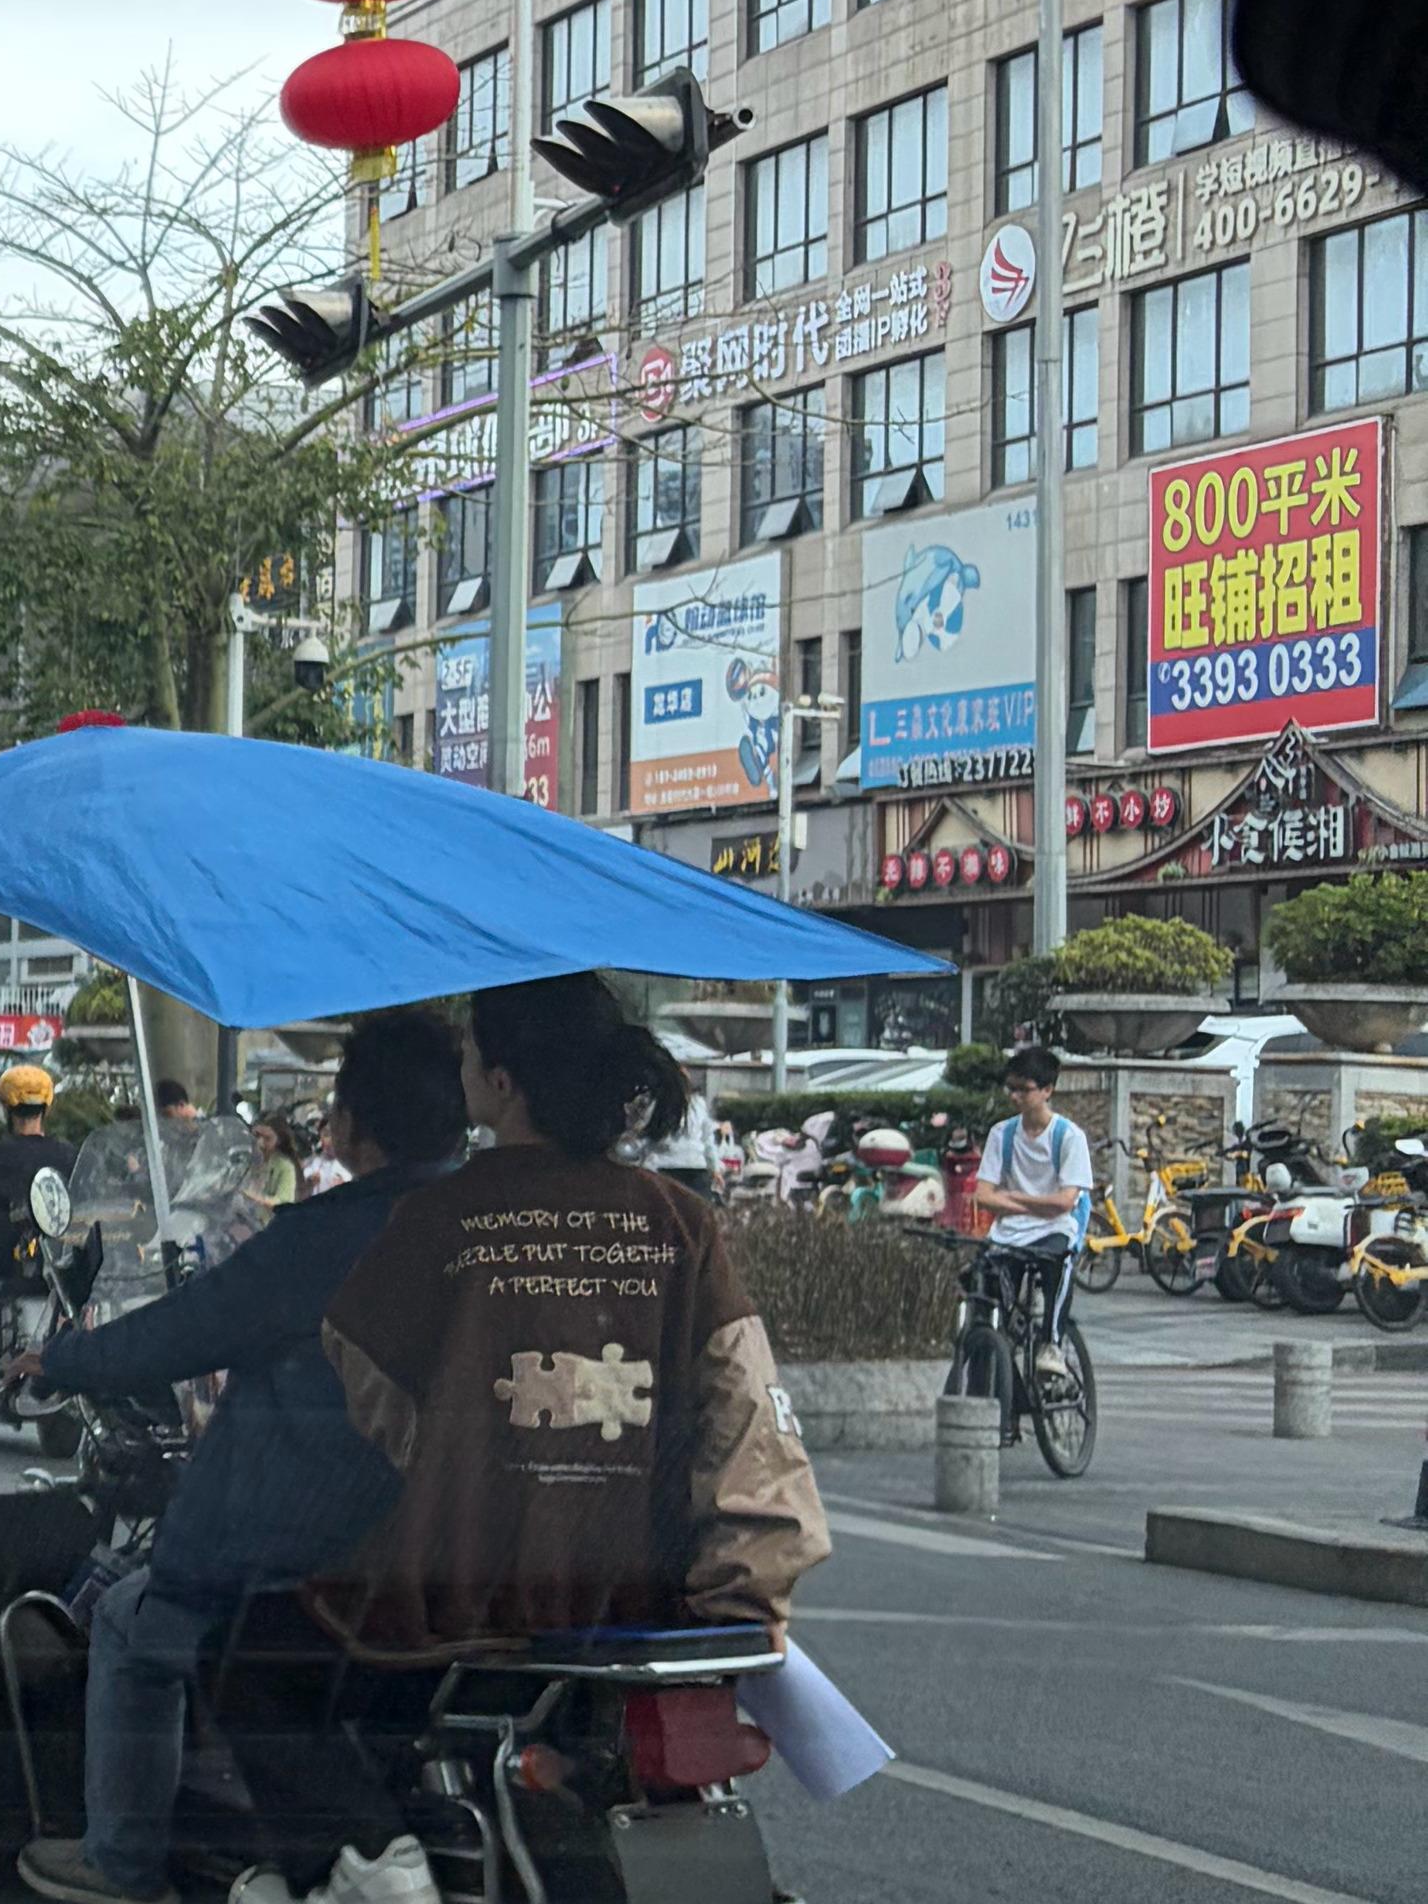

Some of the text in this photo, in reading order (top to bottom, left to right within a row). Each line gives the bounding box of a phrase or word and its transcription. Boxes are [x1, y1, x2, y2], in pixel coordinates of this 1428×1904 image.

[1162, 446, 1361, 553] 800平米
[1164, 529, 1362, 650] 旺铺招租
[1171, 632, 1362, 711] 3393 0333
[461, 1209, 650, 1233] MEMORY OF THE
[522, 1243, 568, 1262] PUT
[489, 1275, 658, 1296] A PERFECT YOU
